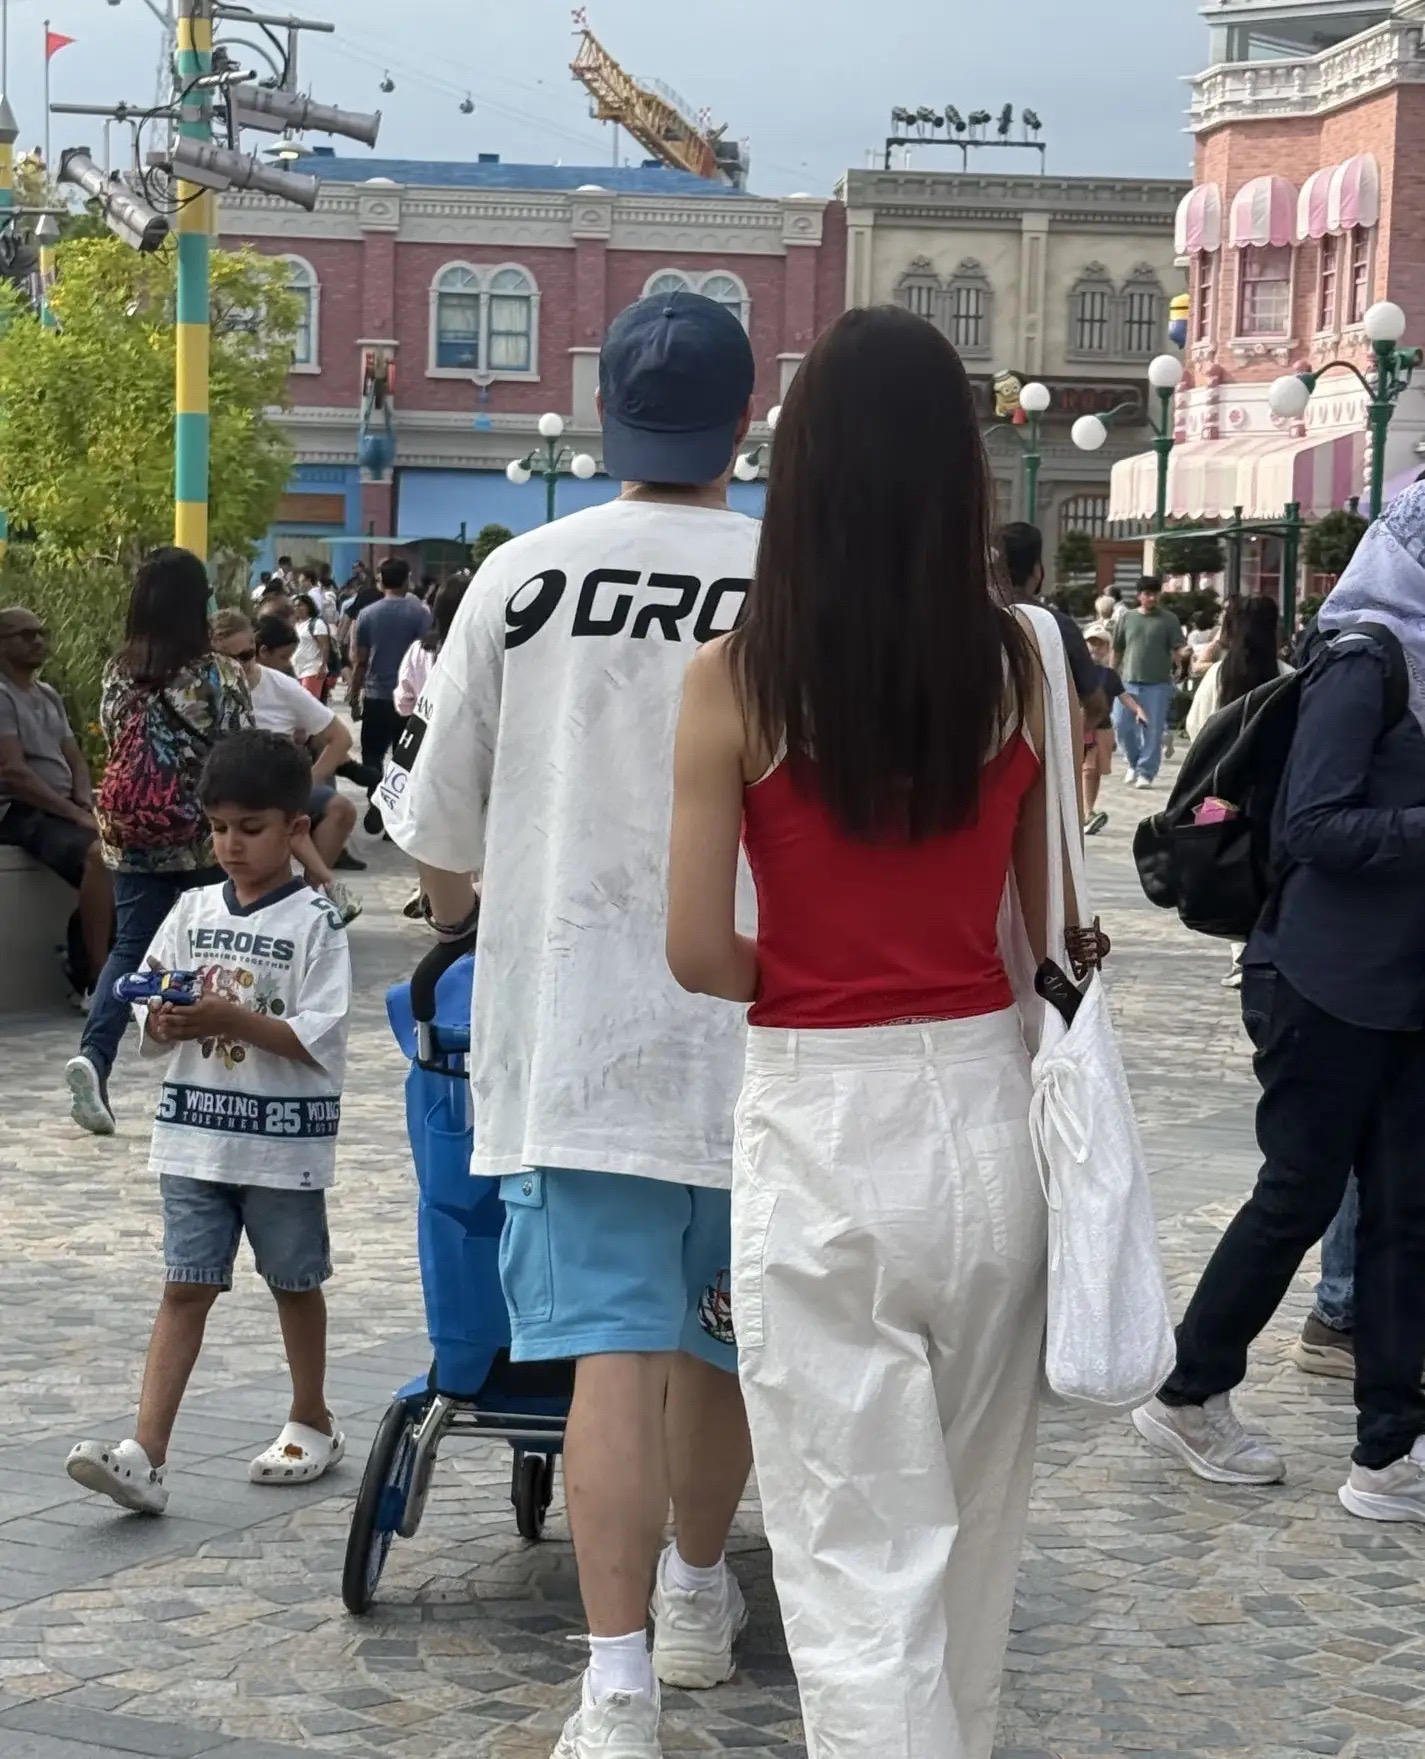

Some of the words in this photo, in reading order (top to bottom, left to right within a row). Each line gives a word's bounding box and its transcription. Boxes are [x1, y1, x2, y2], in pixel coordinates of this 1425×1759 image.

[157, 1086, 178, 1118] 5
[185, 1088, 259, 1118] WORKING
[265, 1101, 301, 1134] 25
